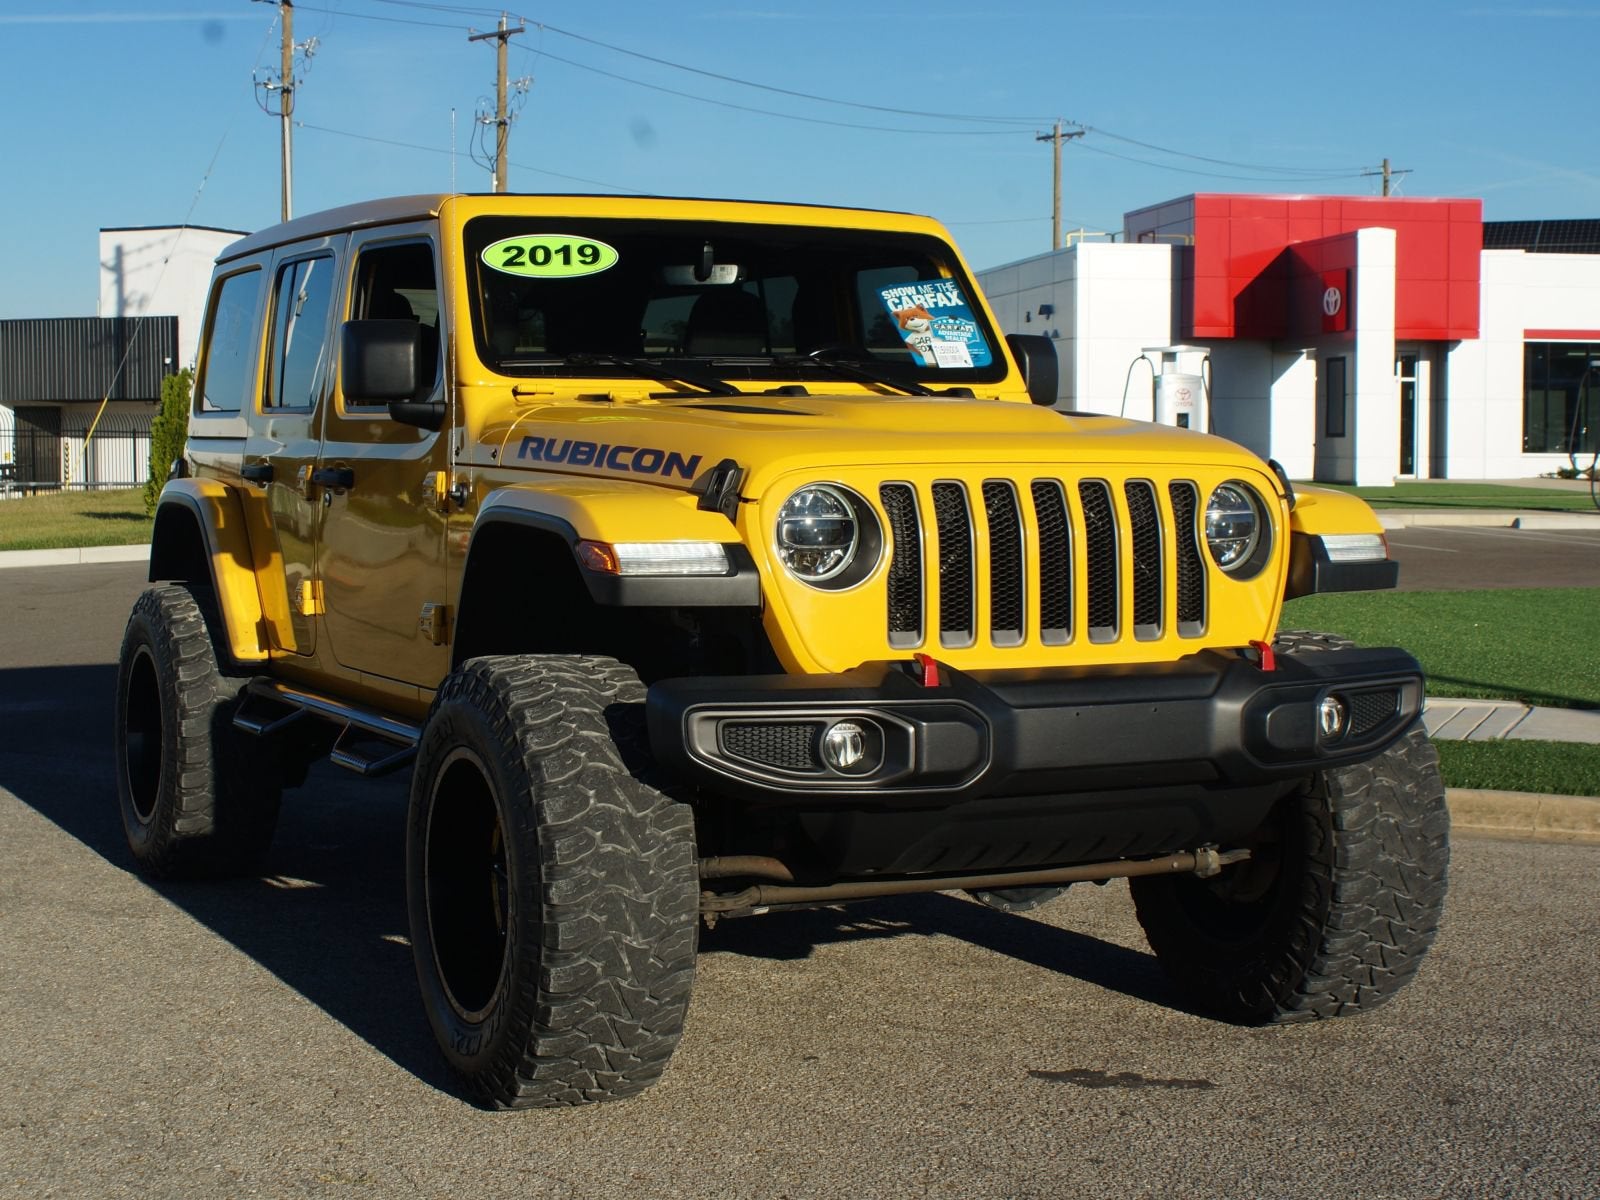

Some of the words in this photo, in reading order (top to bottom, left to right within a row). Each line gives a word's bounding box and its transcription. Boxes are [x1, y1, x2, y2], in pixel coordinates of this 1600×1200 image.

[502, 244, 600, 267] 2019
[881, 286, 916, 300] SHOW
[918, 284, 935, 294] ME
[935, 282, 957, 293] THE
[887, 291, 964, 312] CARFAX
[517, 435, 702, 480] RUBICON
